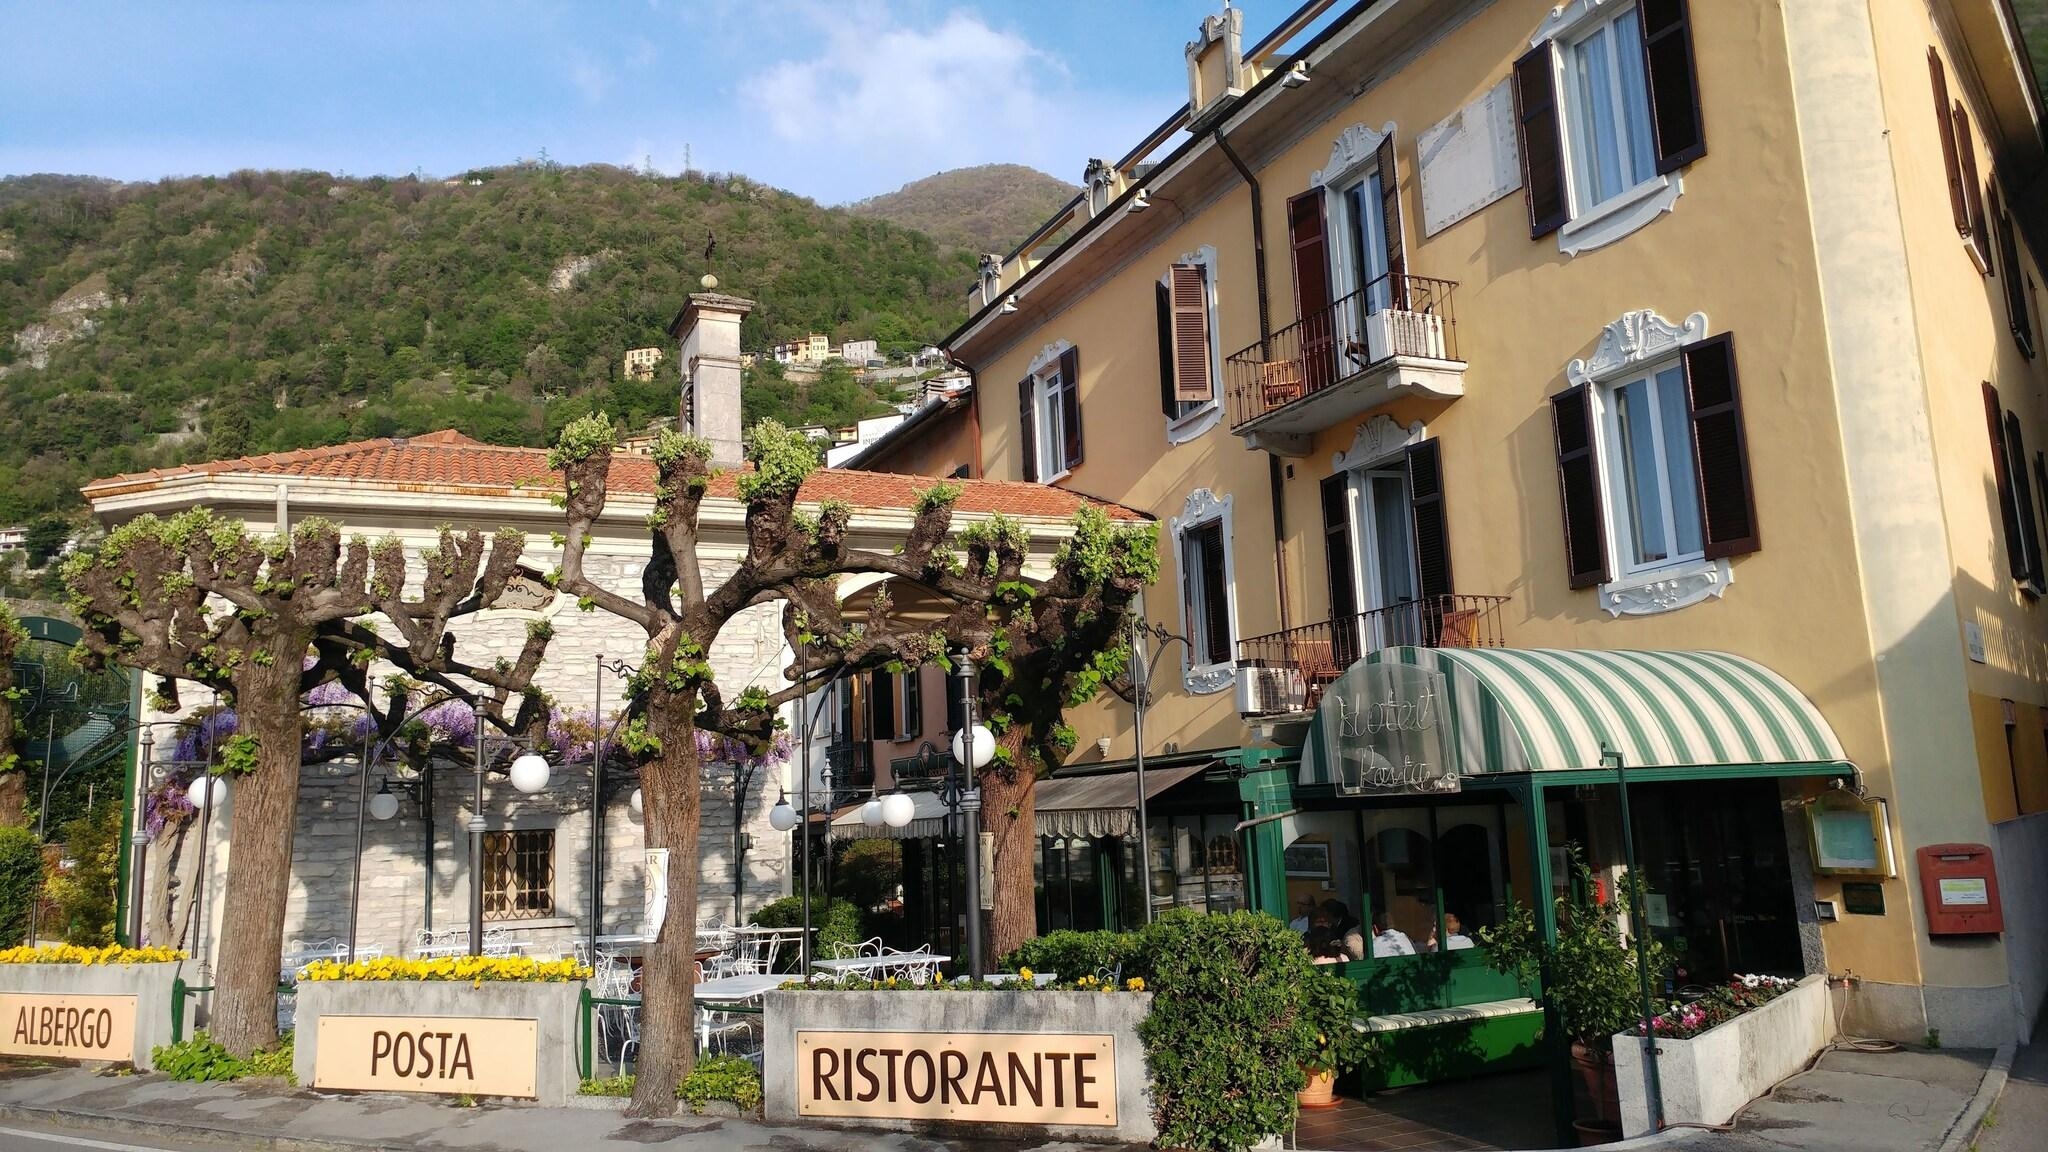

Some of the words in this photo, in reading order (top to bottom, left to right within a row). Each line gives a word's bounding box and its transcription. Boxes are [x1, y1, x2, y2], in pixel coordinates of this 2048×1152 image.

[1336, 687, 1434, 737] Hotel
[13, 1005, 112, 1049] ALBERGO
[371, 1030, 474, 1080] POSTA
[812, 1047, 1099, 1109] RISTORANTE
